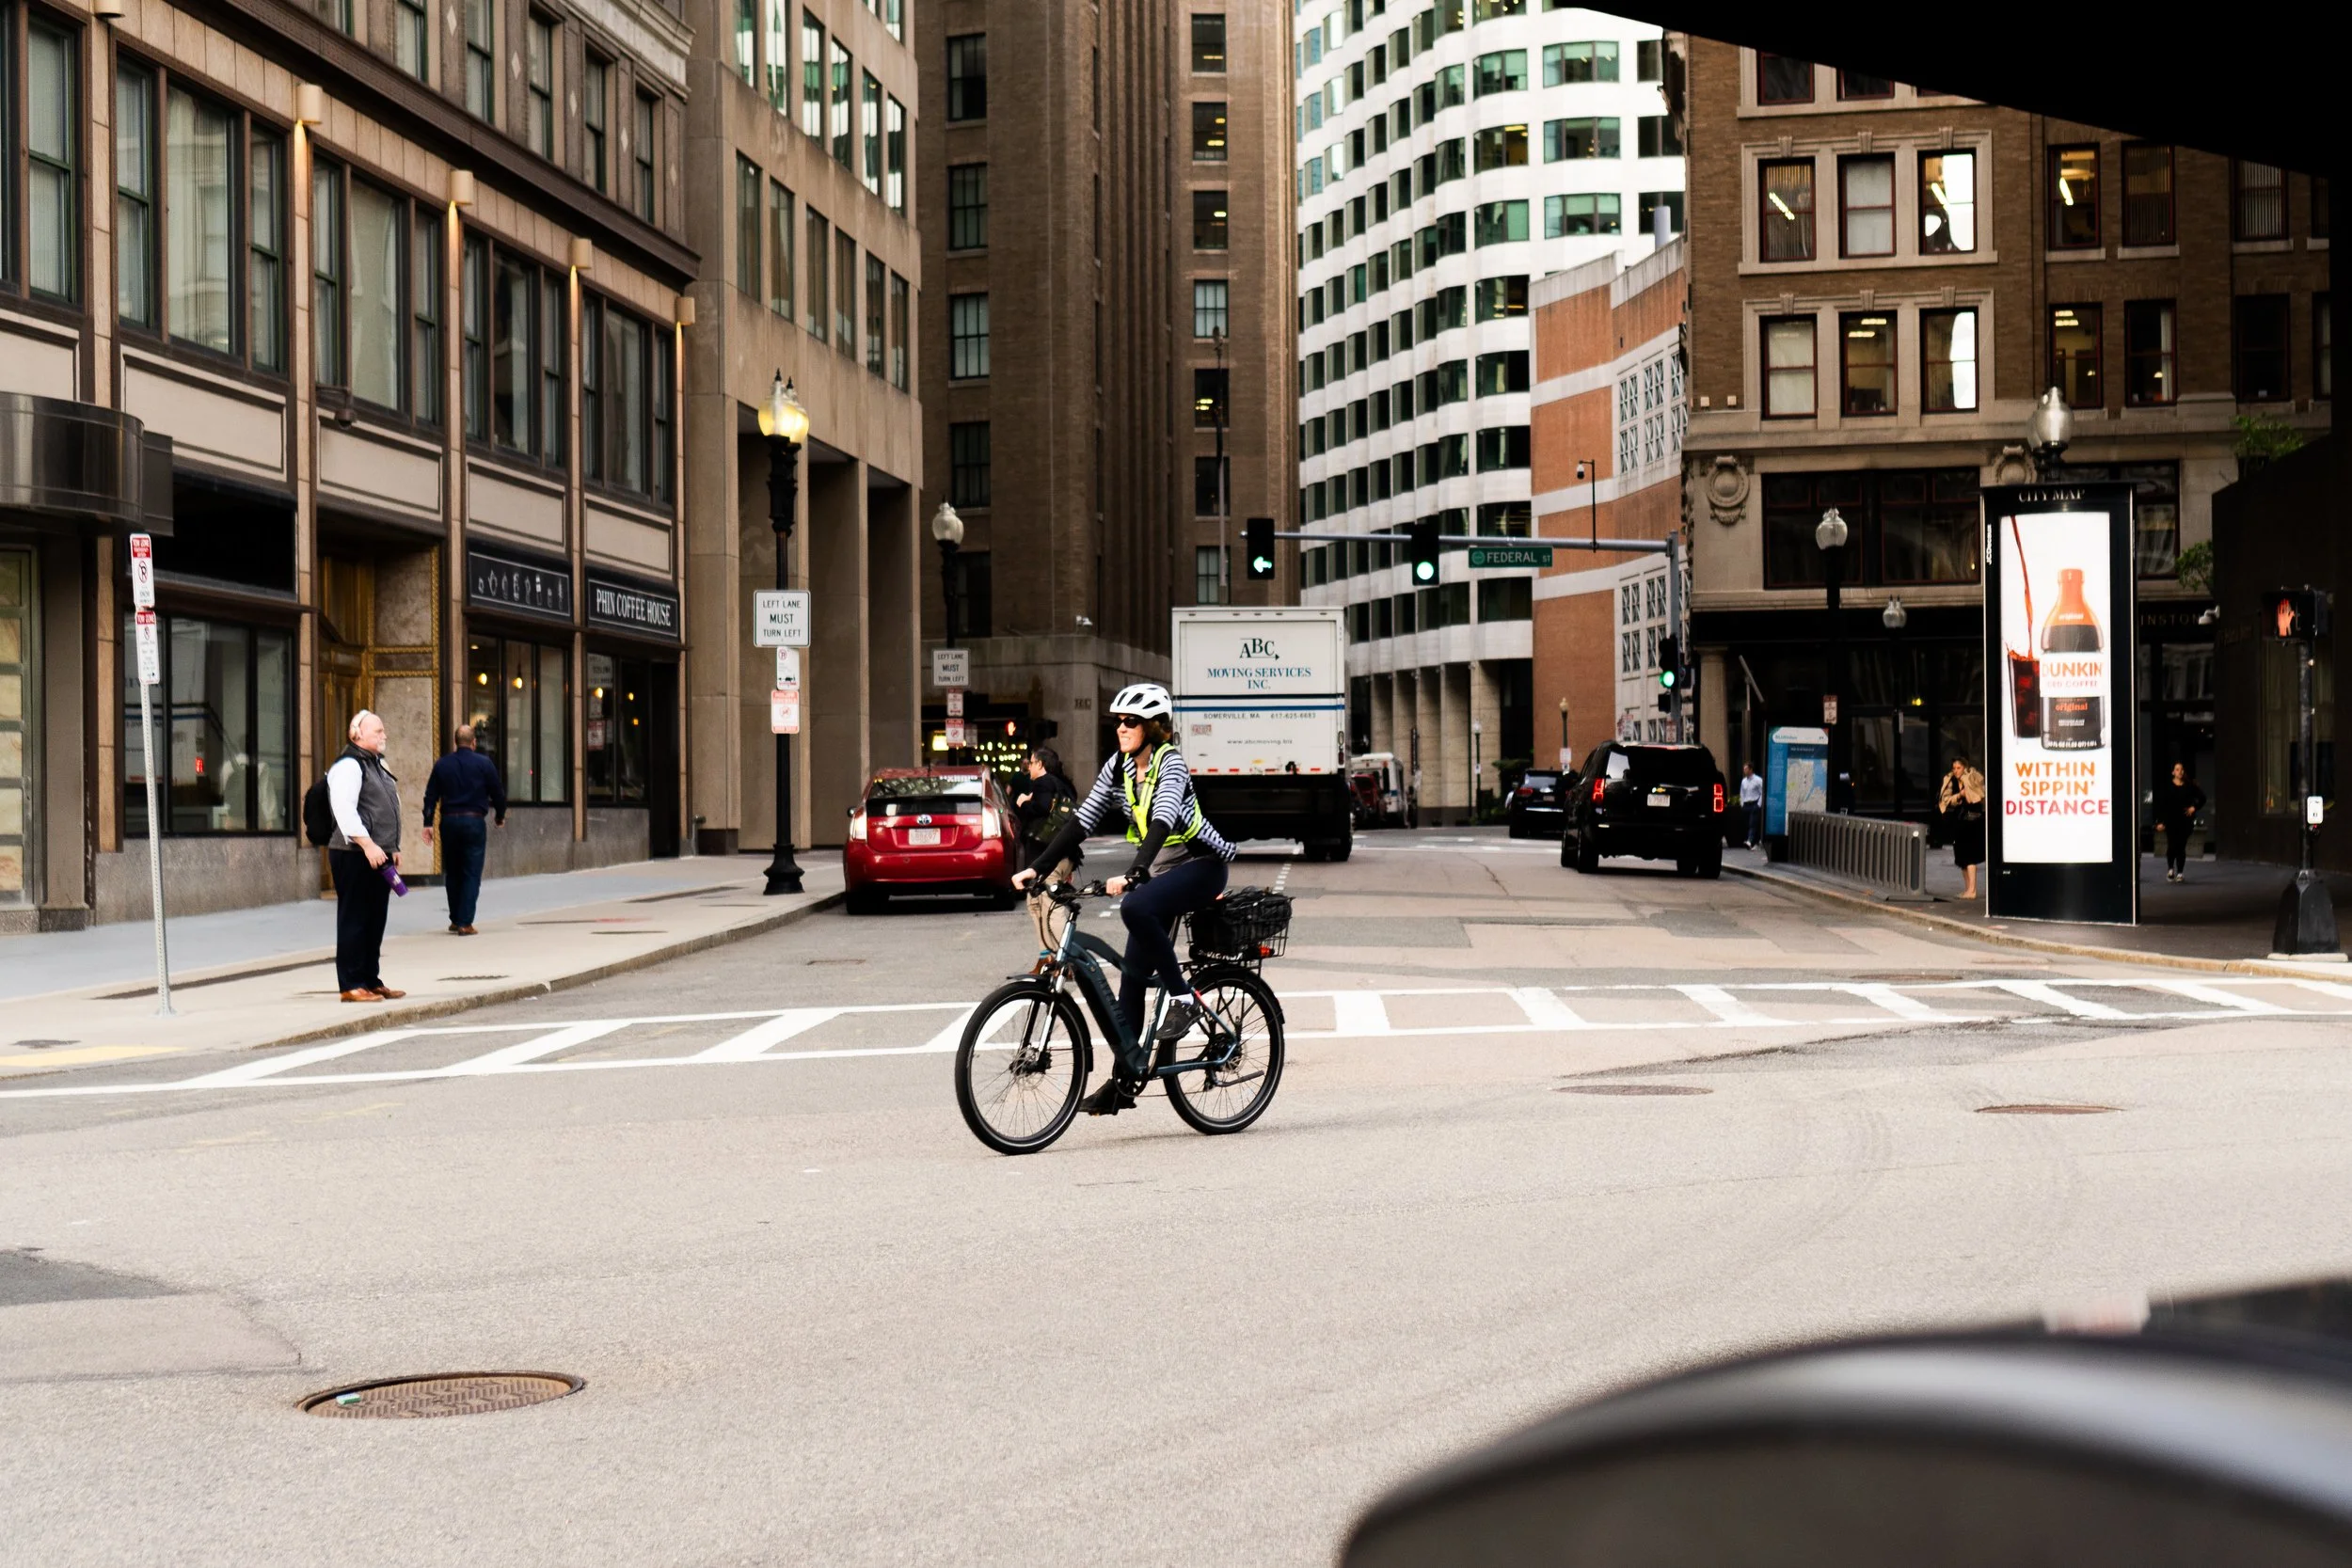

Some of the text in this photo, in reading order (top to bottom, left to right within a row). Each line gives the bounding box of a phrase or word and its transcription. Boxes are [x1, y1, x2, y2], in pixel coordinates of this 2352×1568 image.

[2018, 488, 2086, 502] CITY MAP
[1486, 551, 1537, 563] FEDERAL
[596, 588, 671, 626] PHIN COFFEE HOUSE
[762, 599, 802, 609] LEFT LANE
[770, 613, 794, 625] MUST
[763, 628, 801, 638] TURN LEFT
[1239, 638, 1275, 658] ABC
[942, 663, 960, 673] MUST
[1206, 667, 1311, 678] MOVING SERVICES
[1248, 679, 1271, 690] INC.
[2055, 702, 2089, 712] original
[2015, 761, 2095, 777] WITHIN
[2020, 781, 2095, 797] SIPPIN'
[2005, 800, 2110, 816] DISTANCE
